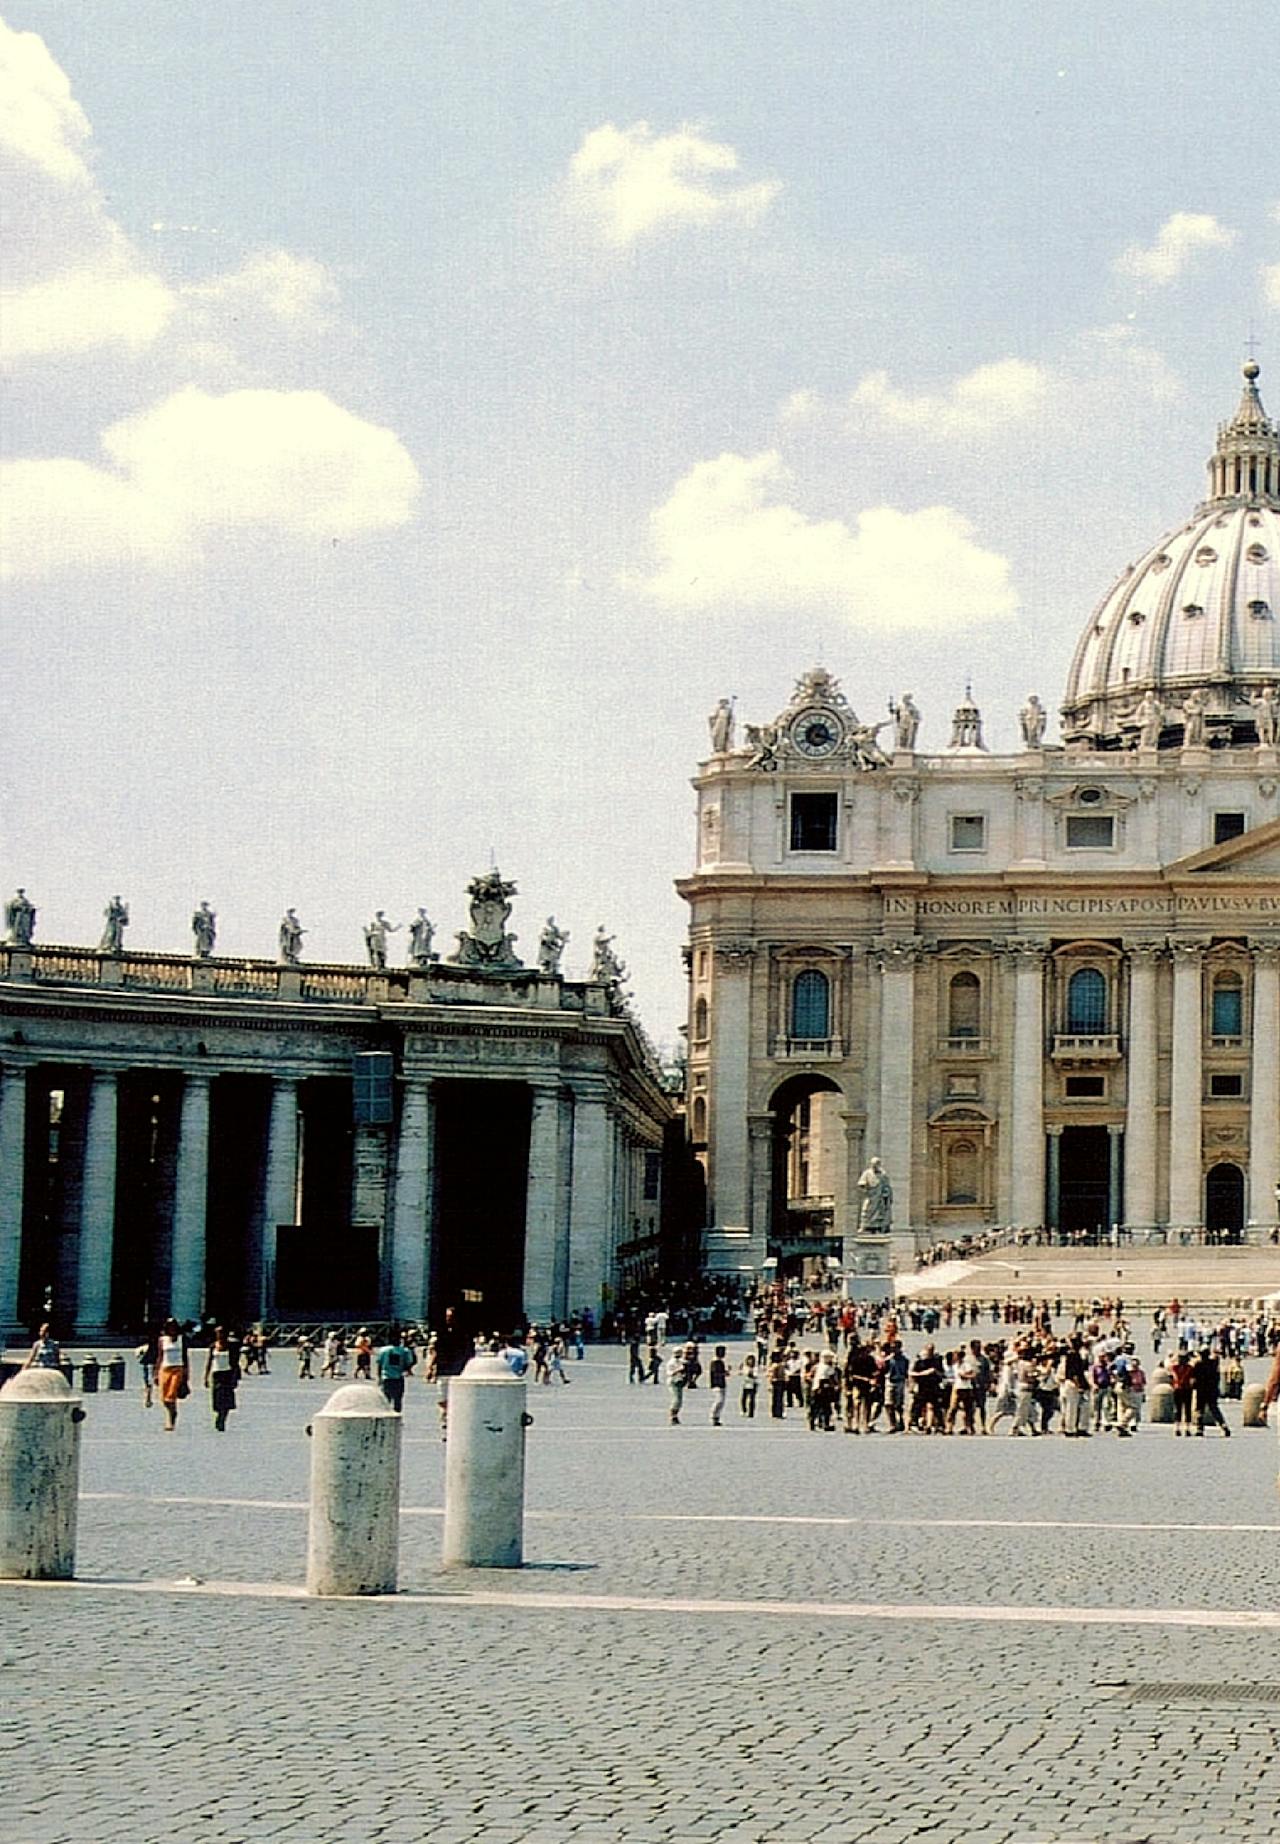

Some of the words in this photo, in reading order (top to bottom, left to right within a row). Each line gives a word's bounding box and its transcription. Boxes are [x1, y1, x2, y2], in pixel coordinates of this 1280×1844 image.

[886, 899, 906, 913] IN
[916, 901, 1014, 915] HONOREM
[1019, 899, 1112, 913] PRINCIPIS
[1115, 898, 1174, 913] APOST
[1179, 896, 1241, 911] PAVLVS
[1243, 897, 1256, 910] V
